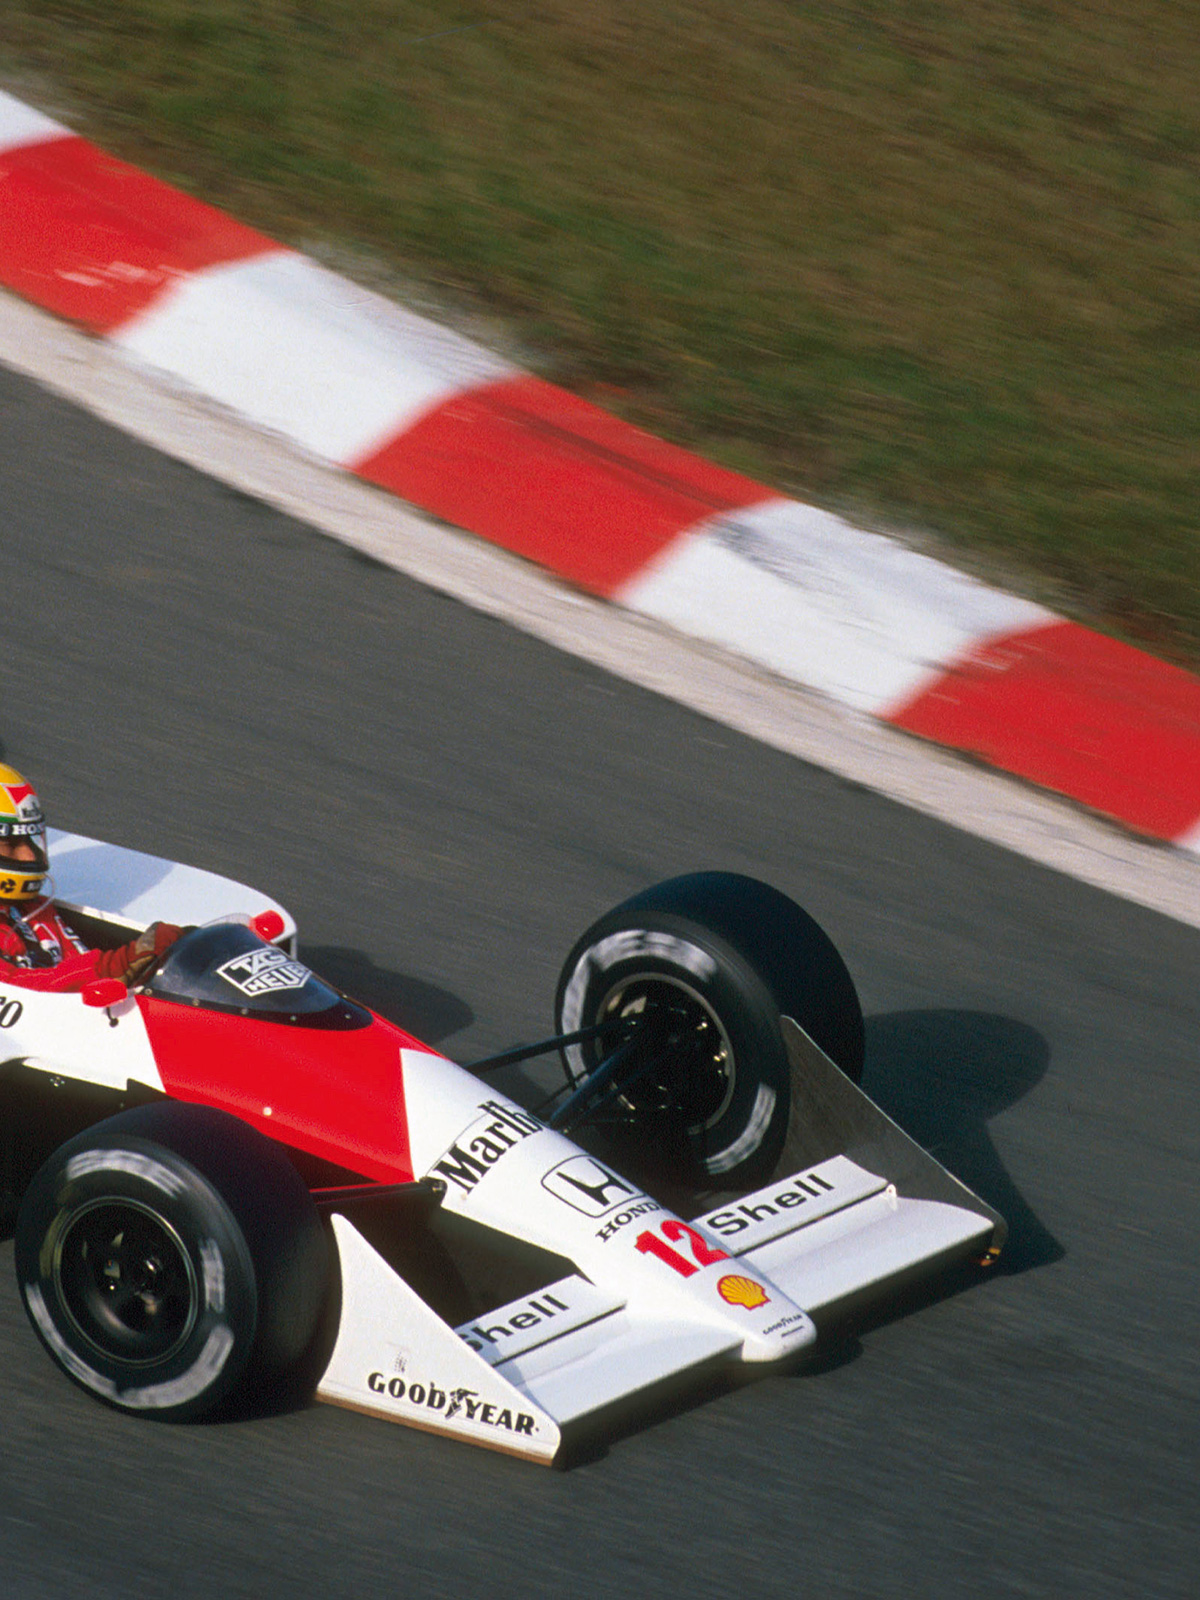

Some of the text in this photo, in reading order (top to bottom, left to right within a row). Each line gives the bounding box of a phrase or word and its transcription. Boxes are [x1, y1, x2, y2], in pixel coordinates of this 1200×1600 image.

[230, 951, 288, 976] TAG
[433, 1100, 548, 1195] Marlb
[595, 1202, 663, 1243] HOND
[707, 1173, 835, 1236] Shell
[634, 1220, 733, 1278] 12
[367, 1372, 535, 1436] GOODYEAR
